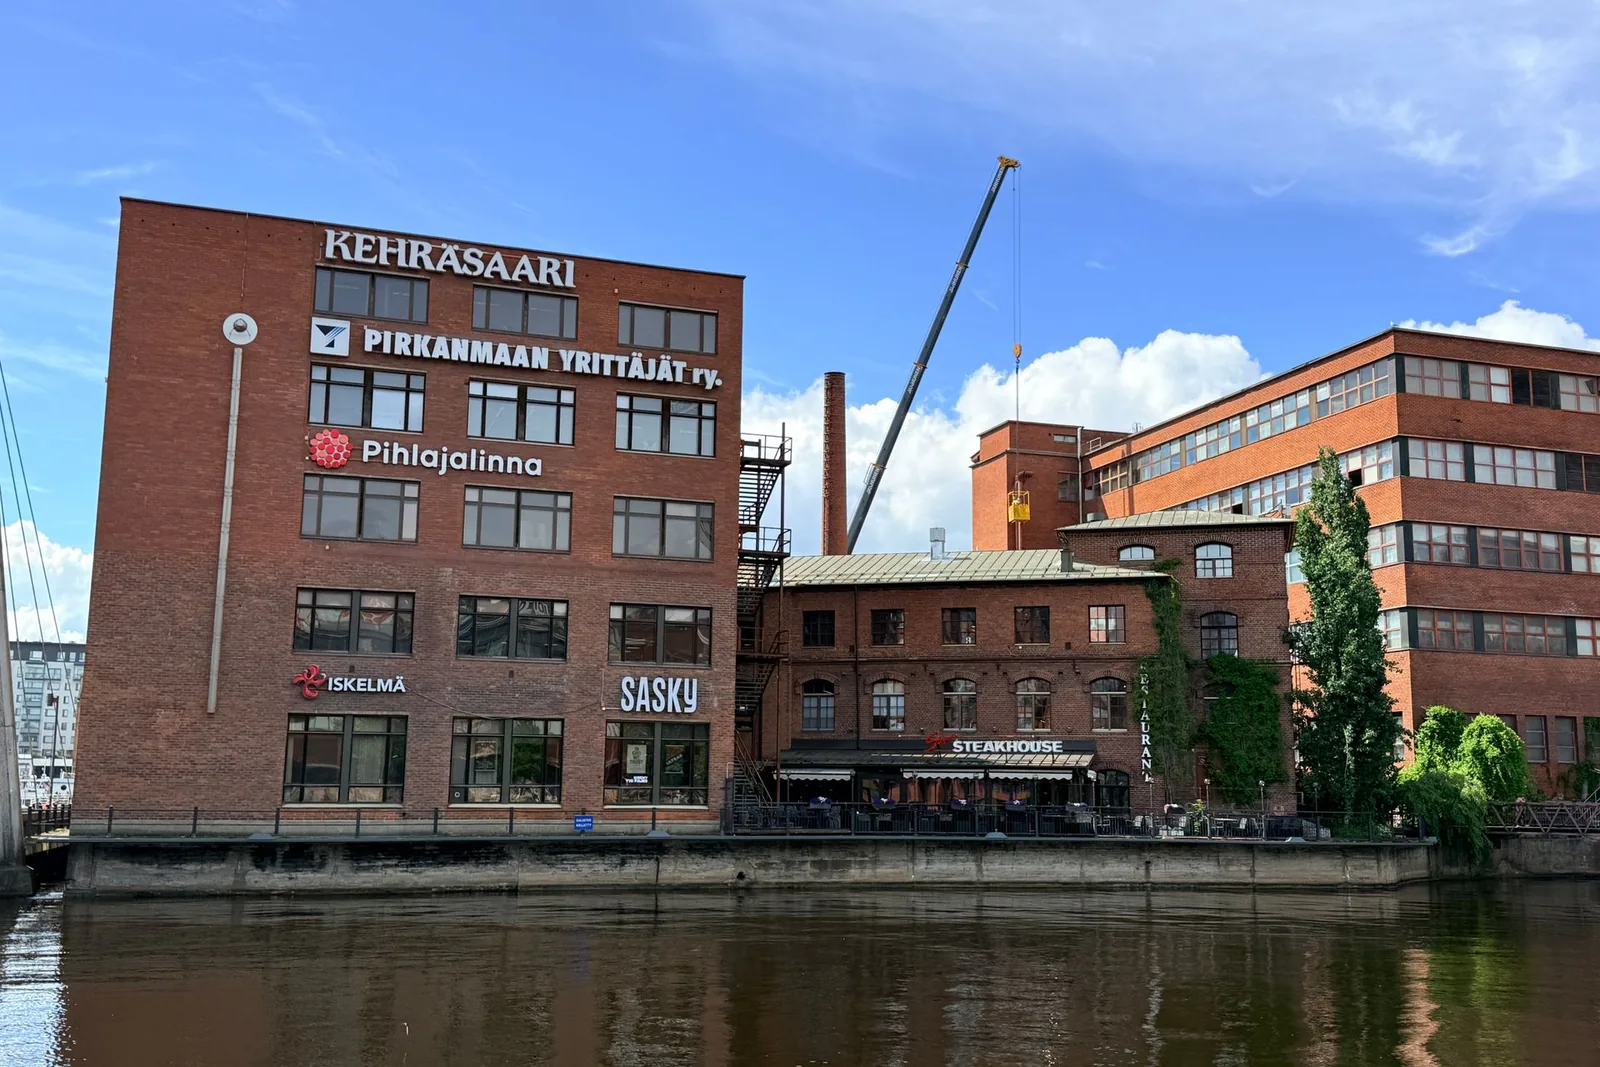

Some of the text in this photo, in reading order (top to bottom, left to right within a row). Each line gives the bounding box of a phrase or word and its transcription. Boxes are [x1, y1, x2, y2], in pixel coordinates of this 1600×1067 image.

[324, 229, 577, 289] KEHRÄSAARI
[363, 328, 723, 391] PIRKANMAAN YRITTÄJÄT ry.
[362, 439, 543, 477] Pihlajalinna
[326, 675, 407, 694] ISKELMÄ
[620, 675, 699, 714] SASKY
[1139, 662, 1153, 782] ESTAURANT
[951, 740, 1064, 753] STEAKHOUSE
